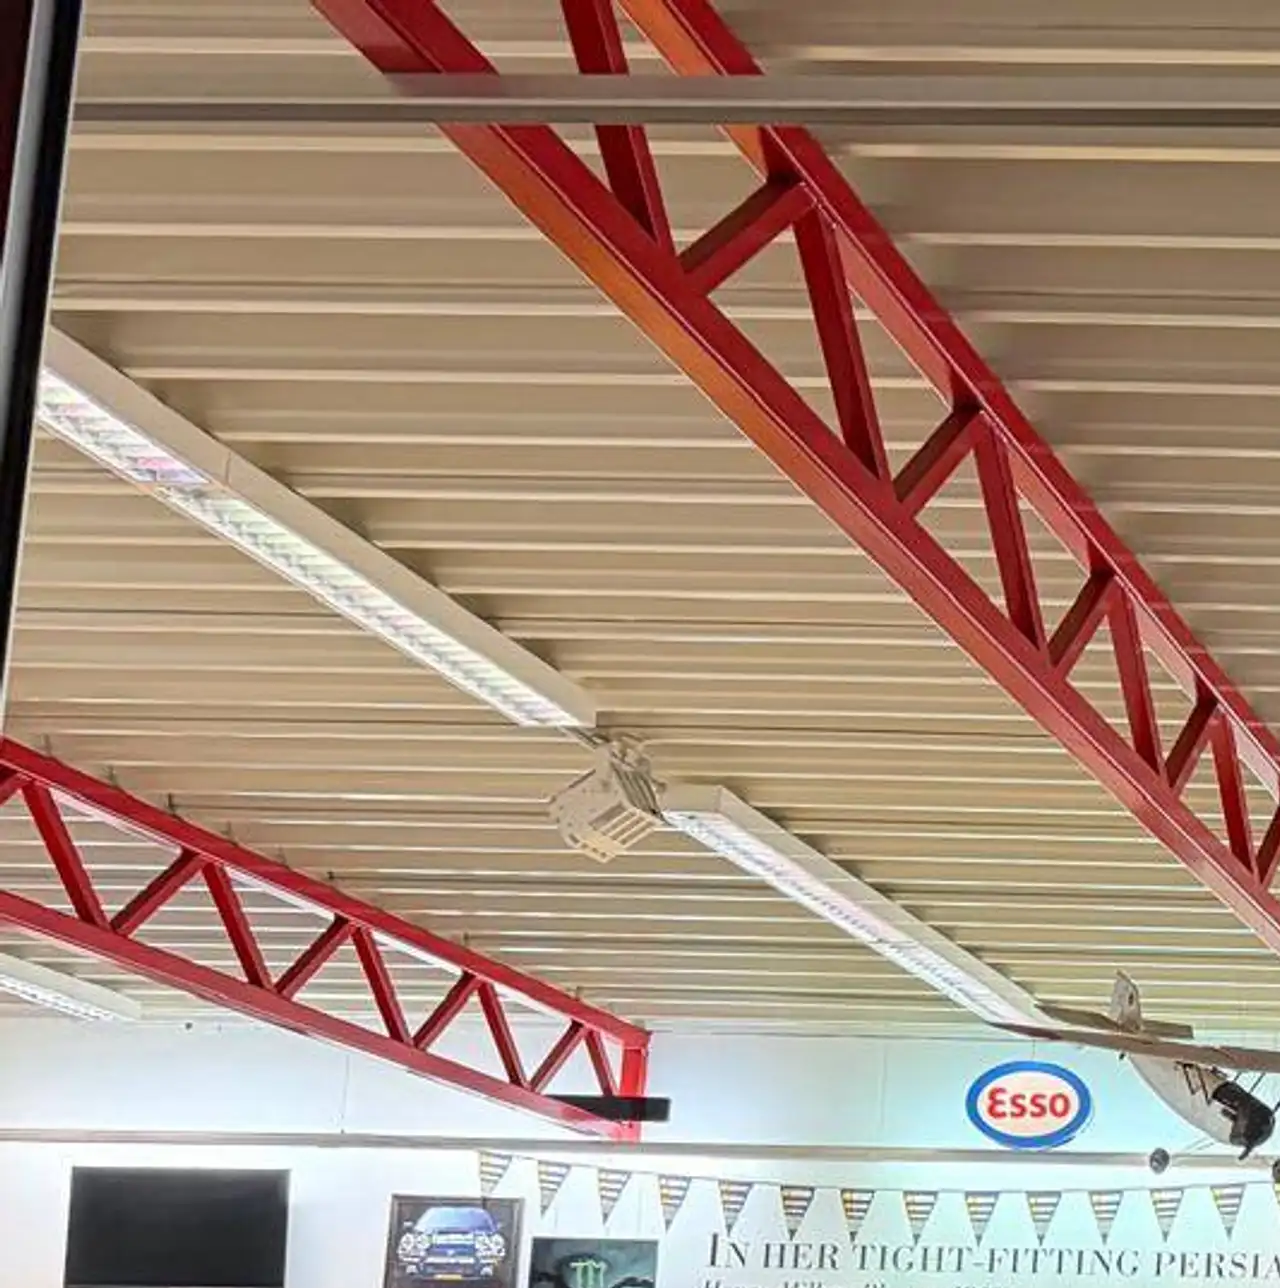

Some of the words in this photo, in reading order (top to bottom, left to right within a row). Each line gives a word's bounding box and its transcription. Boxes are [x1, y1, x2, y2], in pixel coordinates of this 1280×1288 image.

[987, 1087, 1071, 1118] Esso
[762, 1243, 840, 1271] HER
[852, 1244, 1140, 1277] TIGHT-FITTING
